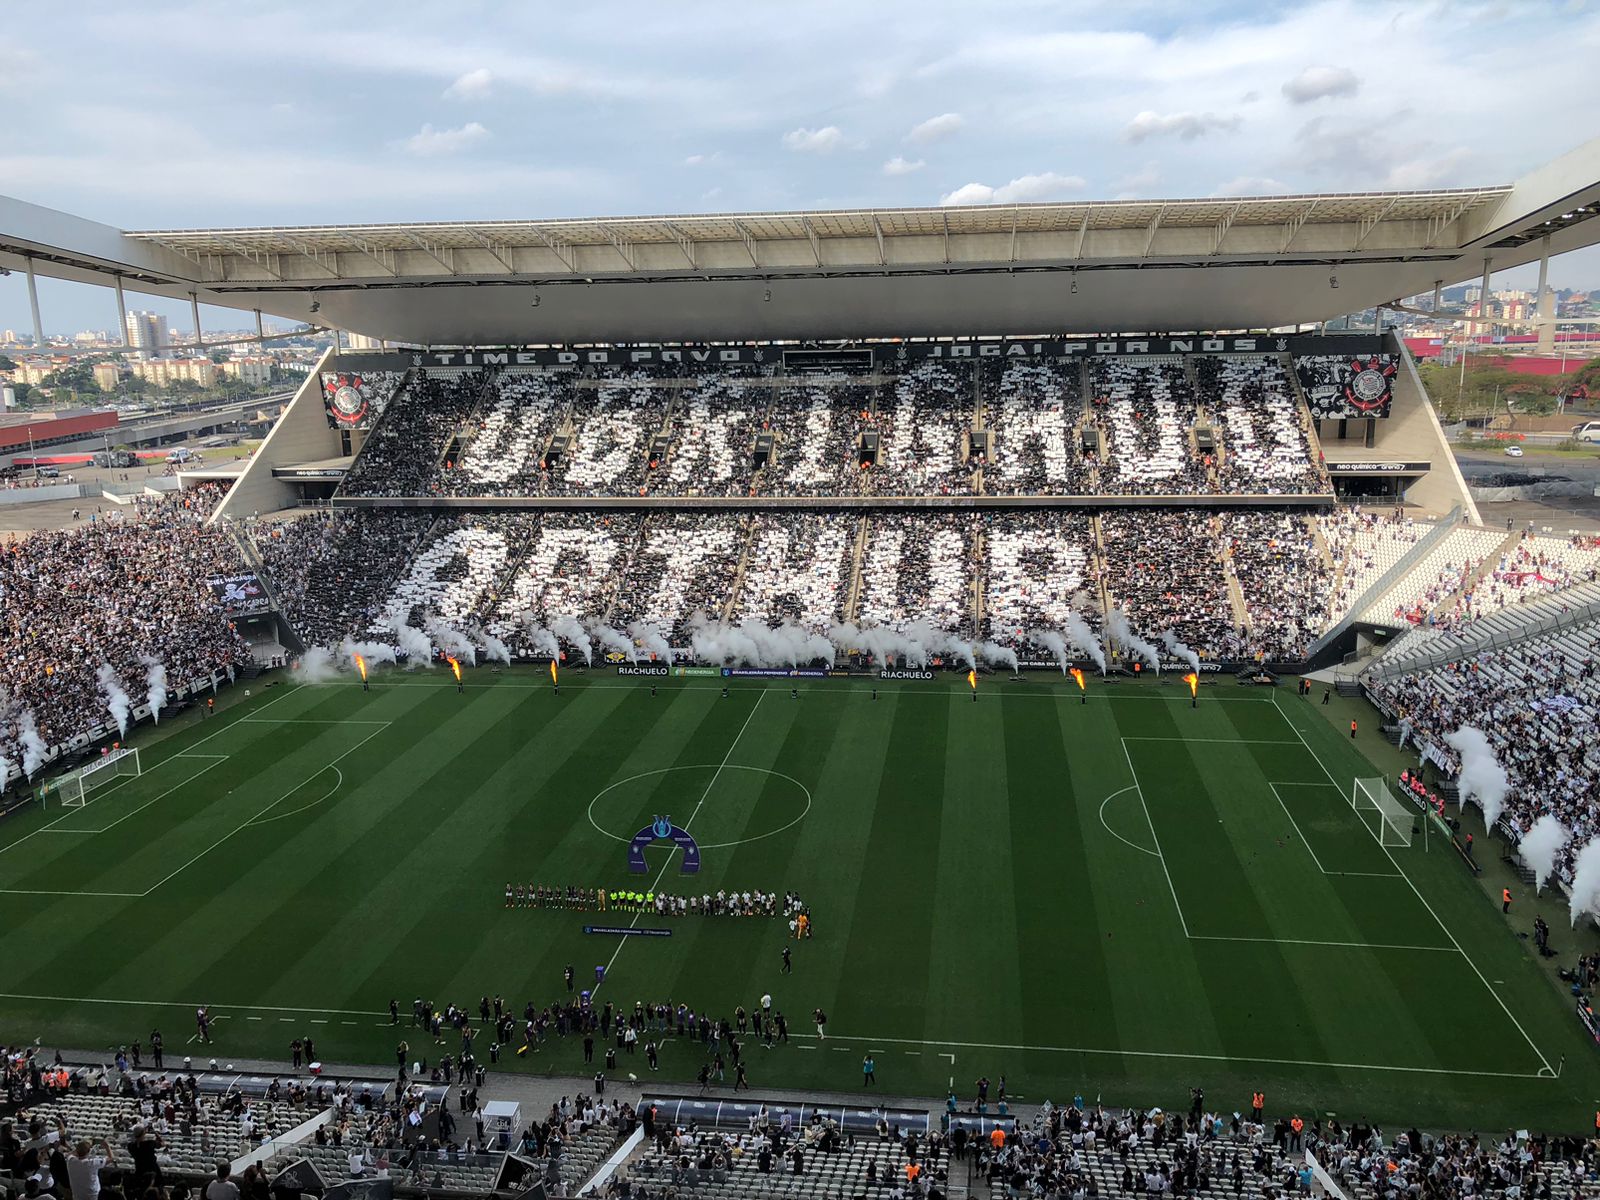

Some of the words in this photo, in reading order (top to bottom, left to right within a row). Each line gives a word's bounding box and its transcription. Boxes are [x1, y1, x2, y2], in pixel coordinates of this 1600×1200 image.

[927, 343, 1042, 358] JOGAI
[1065, 341, 1149, 354] POR
[435, 352, 536, 365] TIME
[558, 352, 608, 363] DO
[631, 350, 740, 362] POVO
[618, 666, 668, 675] RIACHUELO
[881, 671, 932, 679] RIACHUELO
